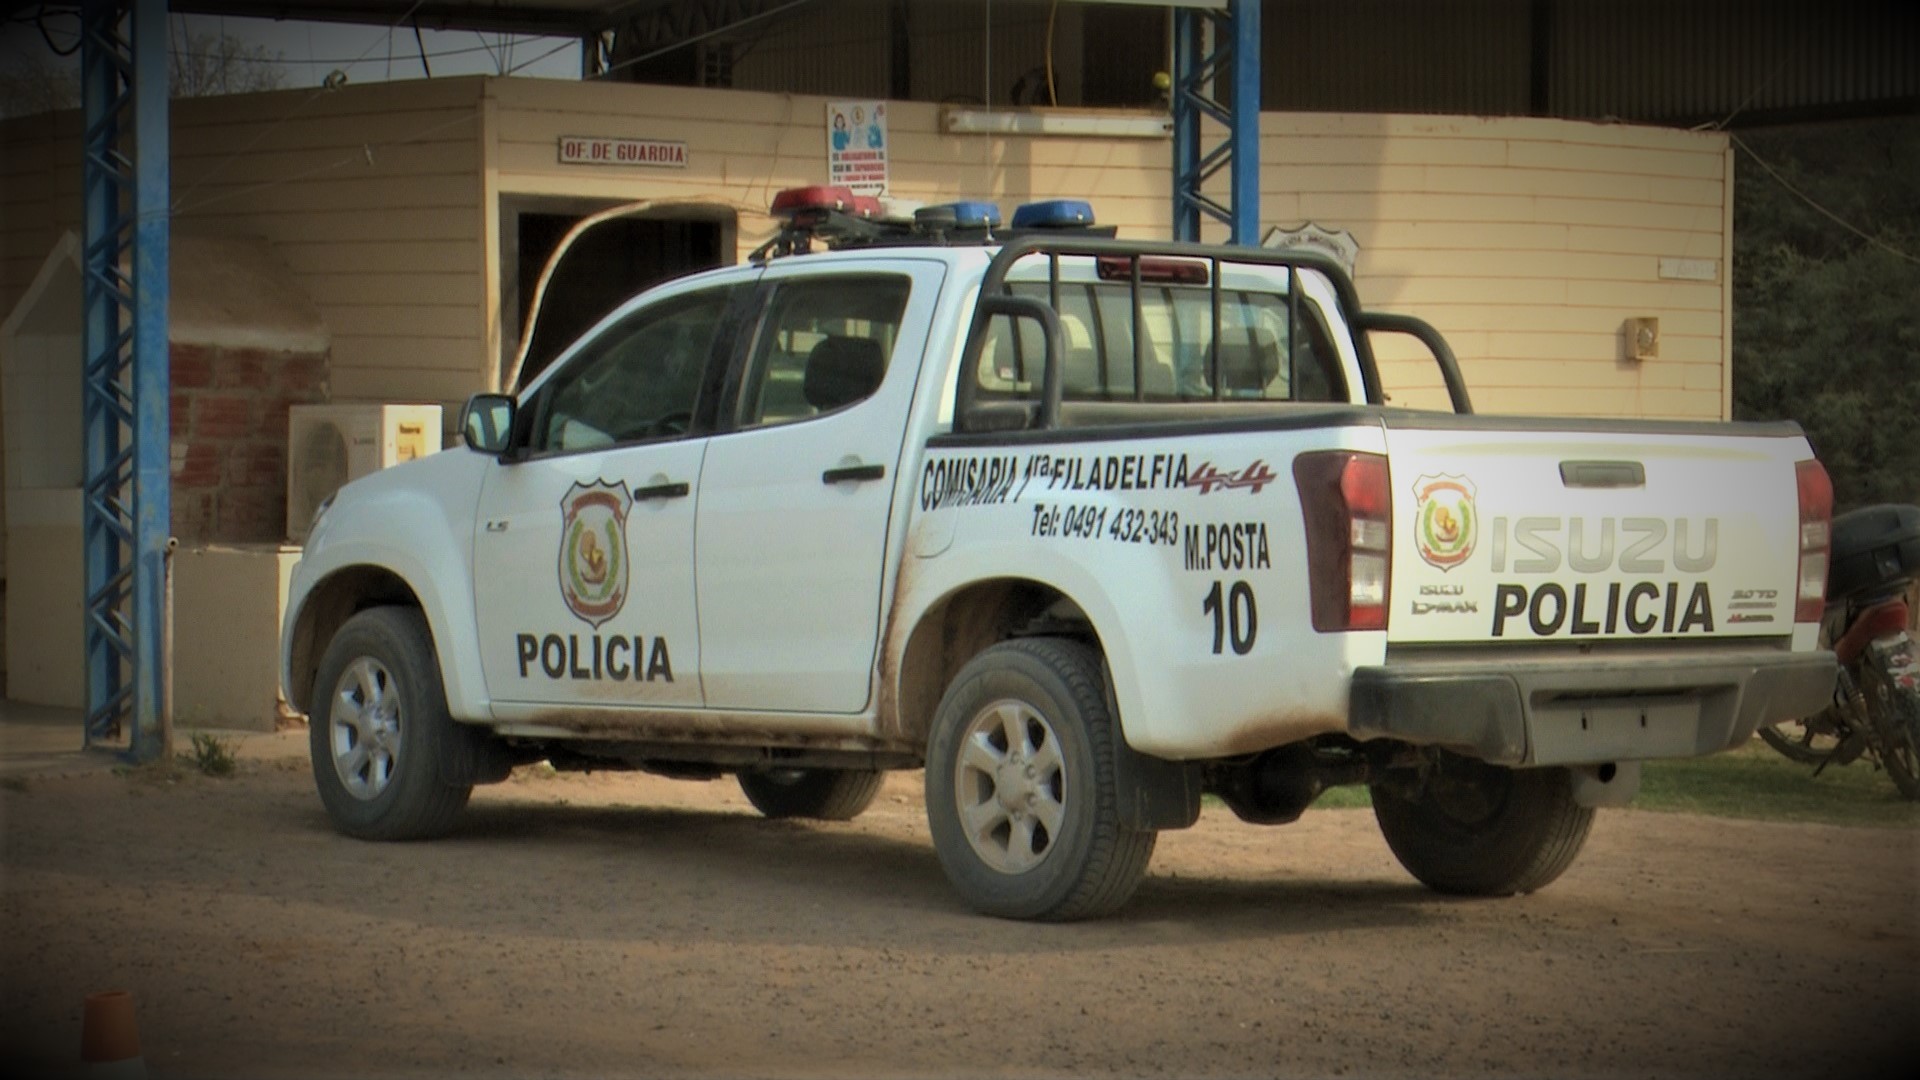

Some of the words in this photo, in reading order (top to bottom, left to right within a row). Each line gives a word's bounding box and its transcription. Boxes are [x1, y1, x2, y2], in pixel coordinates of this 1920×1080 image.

[616, 143, 684, 163] GUARDIA
[921, 457, 1017, 511] COMISARIA
[1048, 453, 1188, 490] FILADELFIA
[1031, 503, 1060, 537] Tel:
[1063, 504, 1107, 539] 0491
[1109, 507, 1178, 546] 432-343
[1491, 516, 1719, 574] ISUZU
[1203, 580, 1258, 656] 10
[1491, 581, 1715, 637] POLICIA
[516, 633, 674, 683] POLICIA
